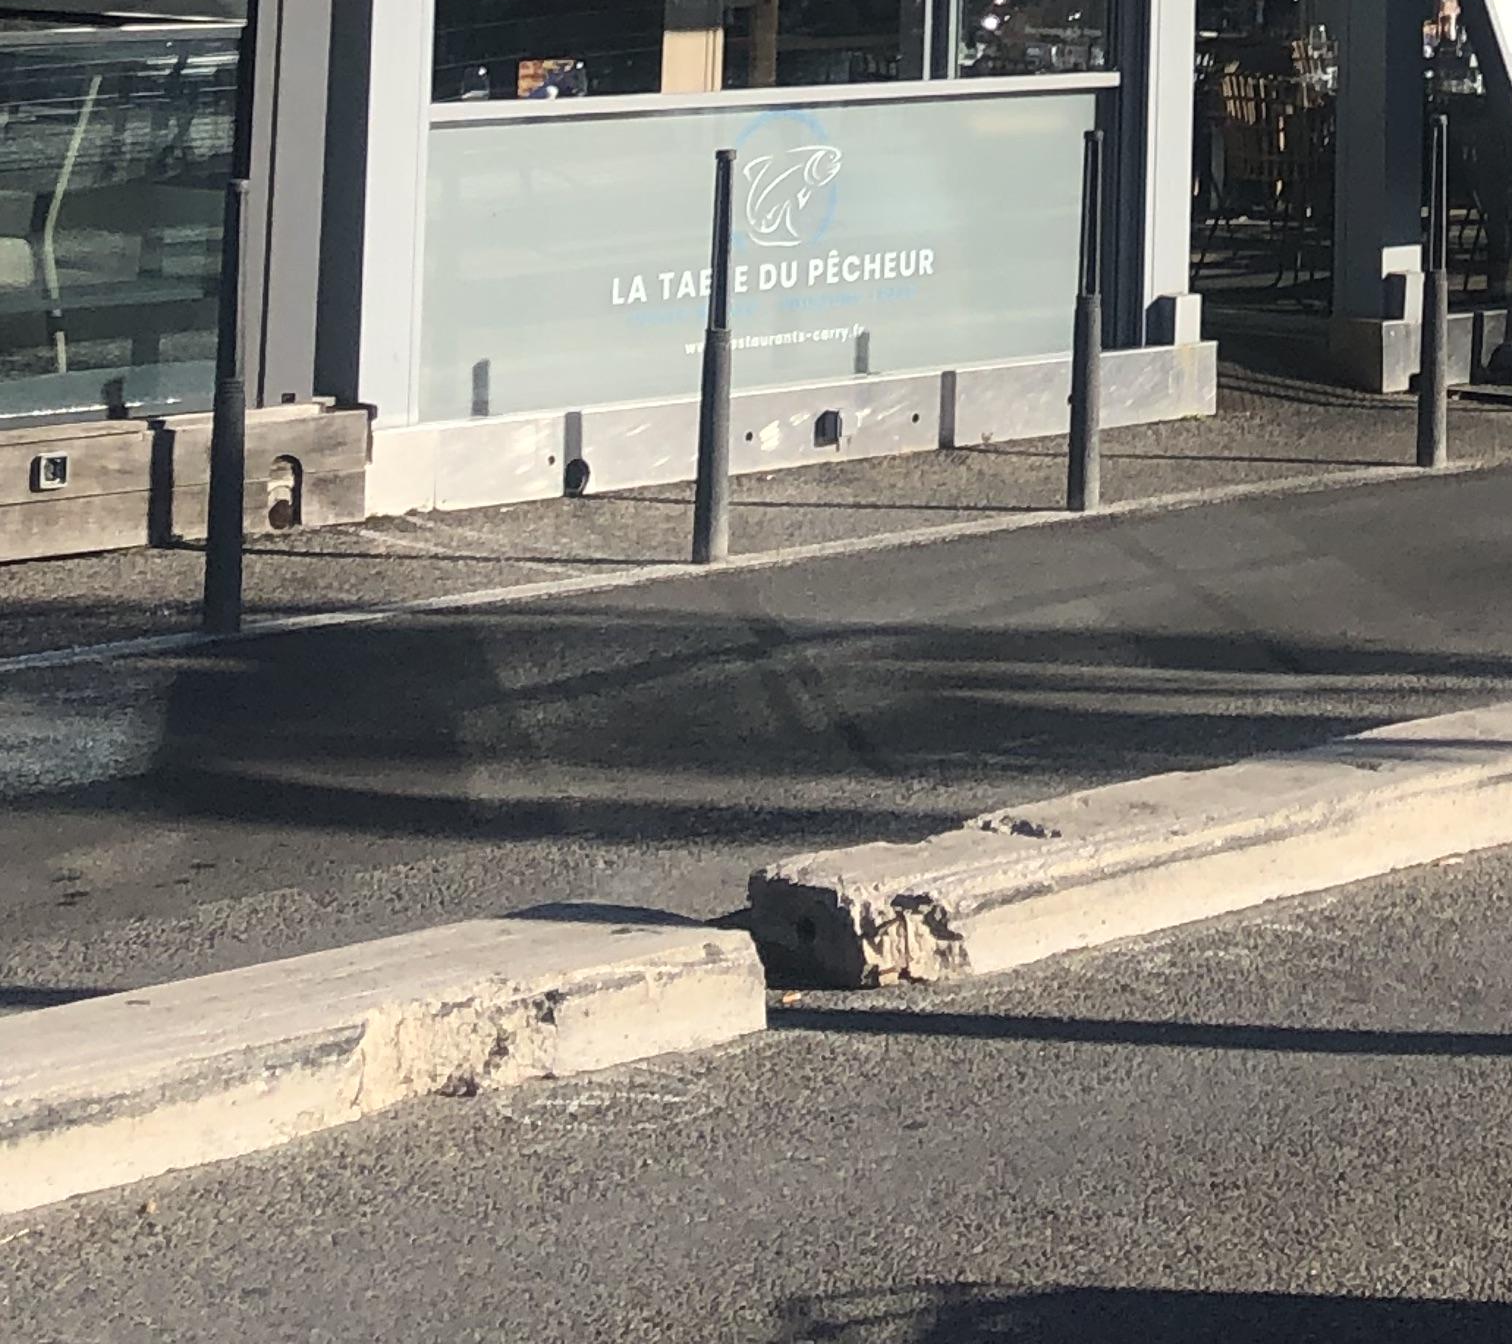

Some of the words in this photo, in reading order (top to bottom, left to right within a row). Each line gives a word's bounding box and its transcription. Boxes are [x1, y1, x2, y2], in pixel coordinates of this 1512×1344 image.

[611, 274, 649, 306] LA
[658, 264, 749, 301] TABE
[758, 259, 799, 291] DU
[807, 248, 936, 287] PÊCHEUR
